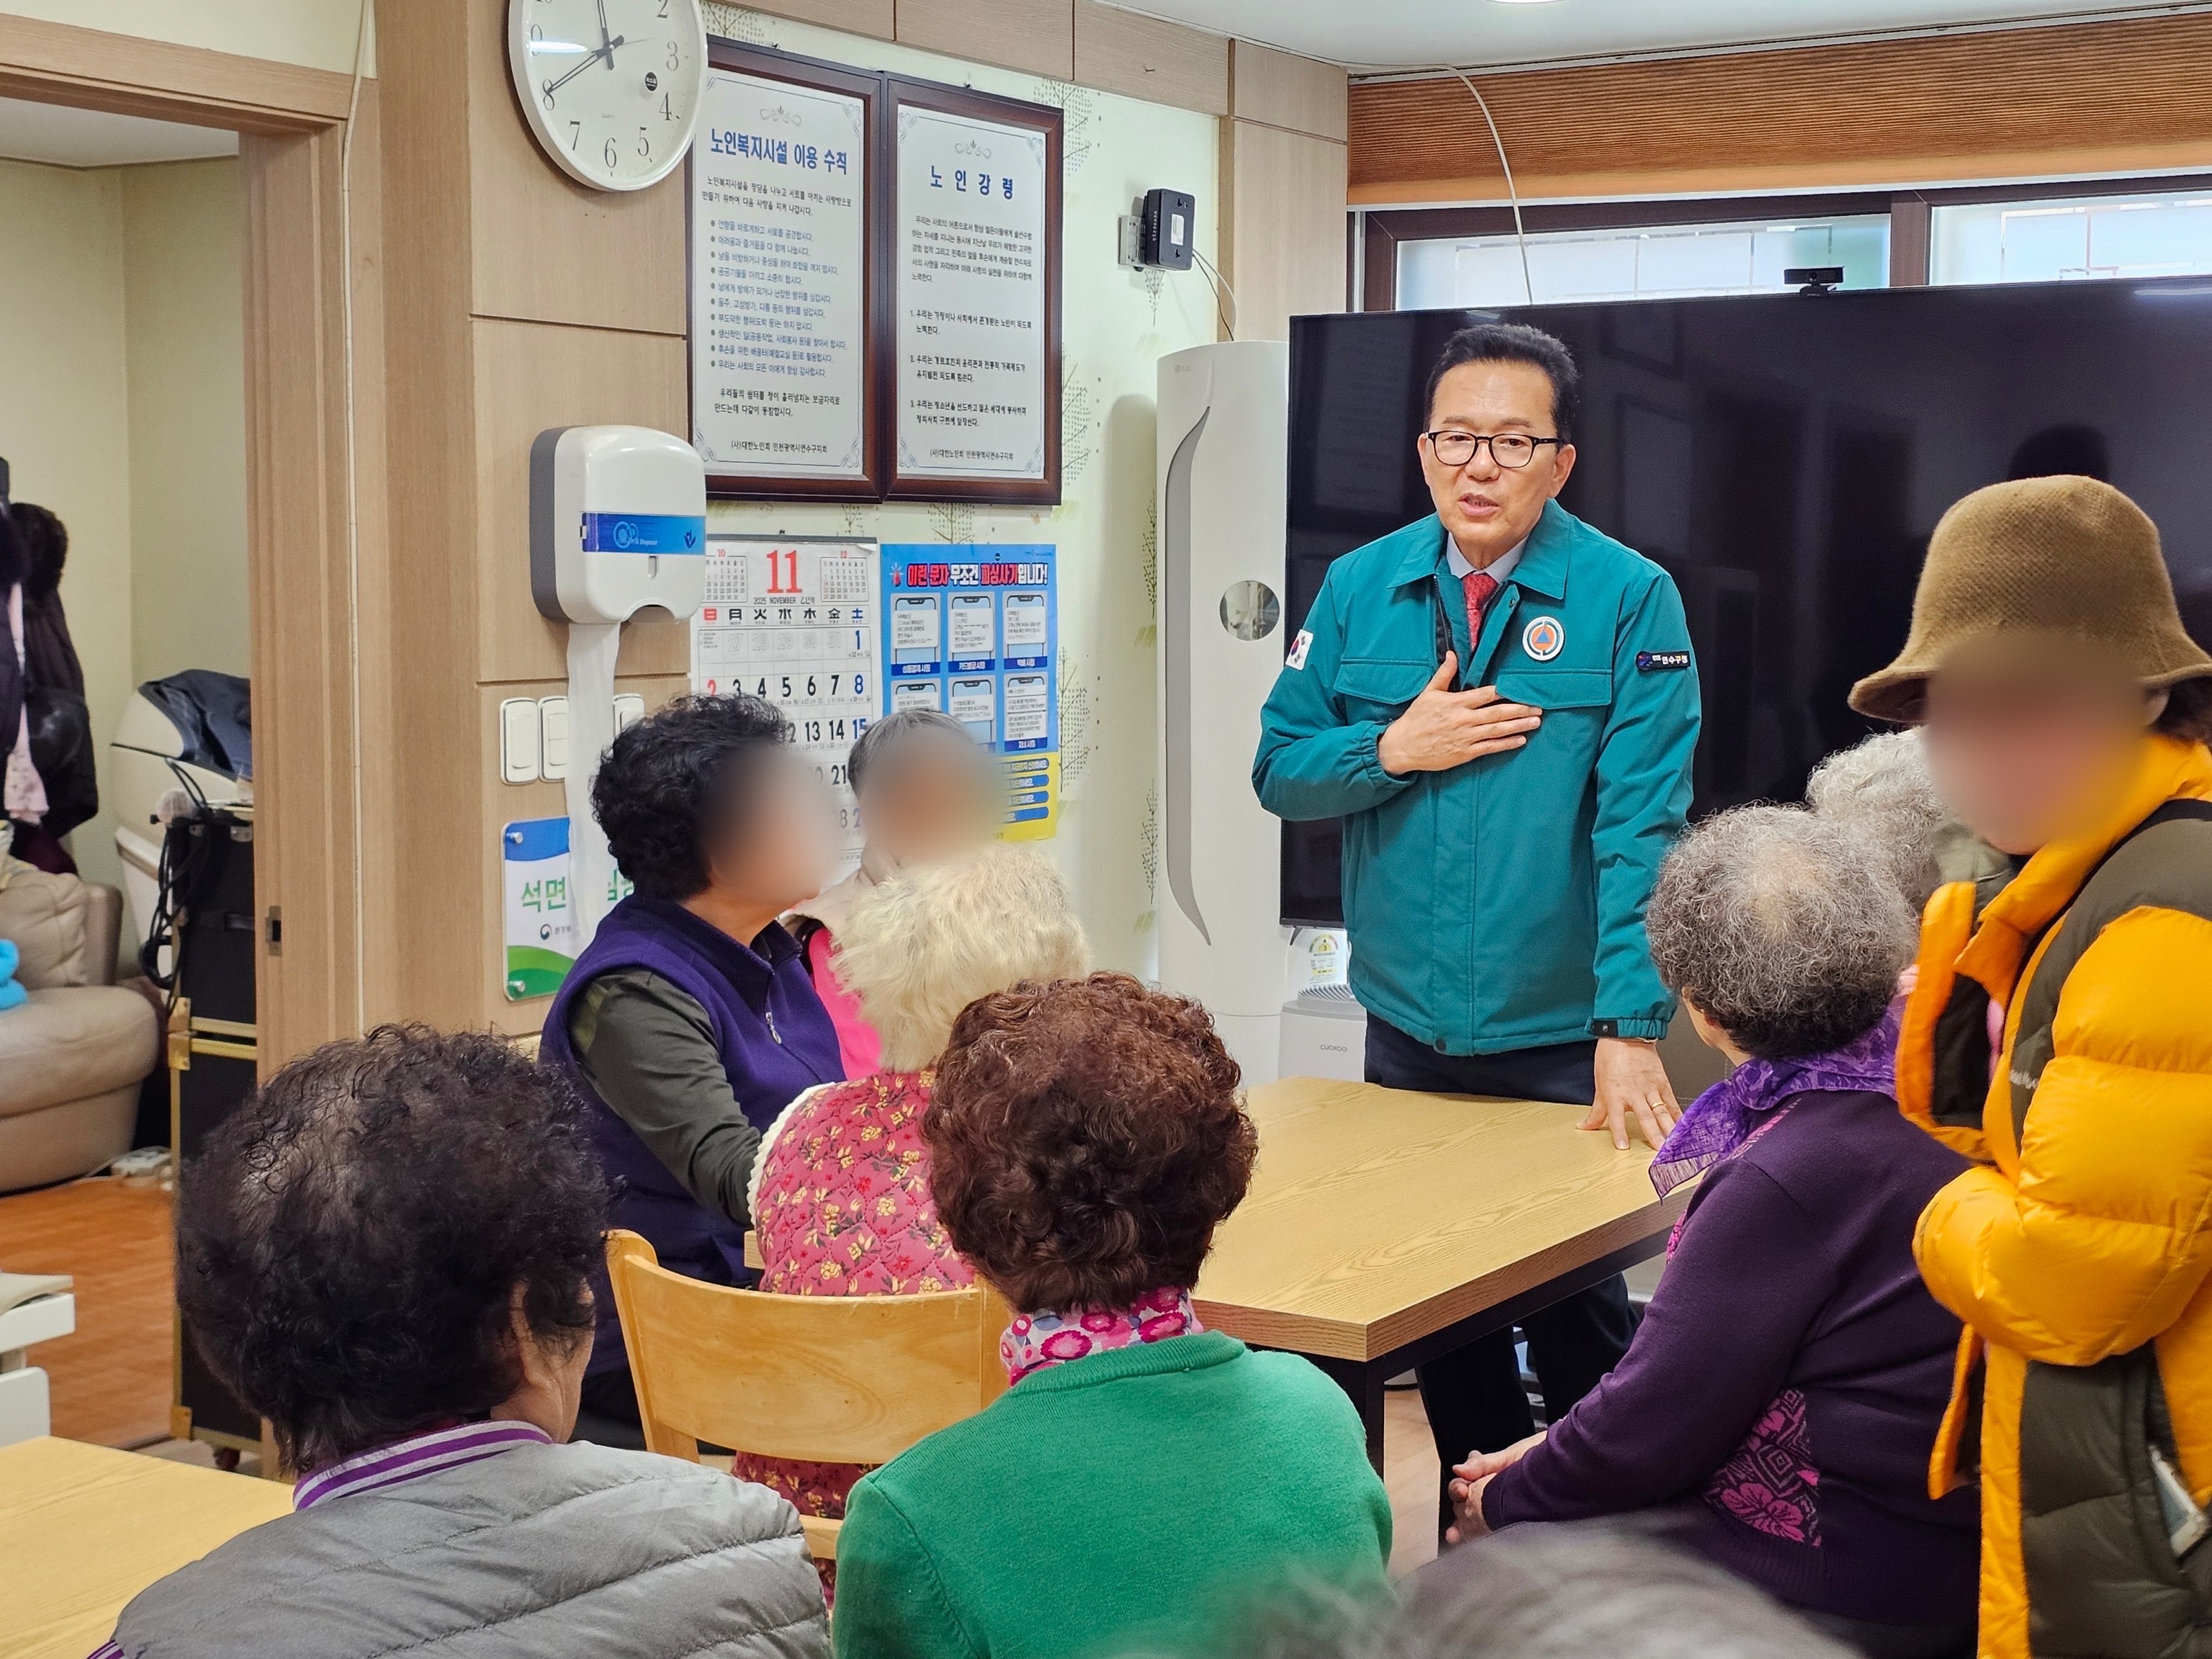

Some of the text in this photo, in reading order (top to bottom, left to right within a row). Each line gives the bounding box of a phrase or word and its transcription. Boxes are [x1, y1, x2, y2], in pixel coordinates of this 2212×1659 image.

[657, 0, 668, 19] 2
[667, 40, 678, 71] 3
[542, 79, 554, 111] 8
[659, 91, 672, 121] 4
[570, 120, 580, 151] 7
[637, 127, 649, 157] 5
[604, 137, 616, 168] 6
[711, 128, 847, 174] 노인복지시설 이용 수칙
[707, 176, 747, 191] 노인복지시설을
[770, 186, 786, 197] 나누고
[790, 189, 804, 200] 서로를
[826, 195, 851, 207] 사랑방으로
[930, 165, 1013, 199] 노 인 강 령
[702, 191, 812, 216] 만들기 위하여 다음 사항을 지켜 나갑시다.
[768, 227, 783, 237] 서로를
[718, 235, 741, 247] 어려움과
[775, 243, 785, 253] 함께
[718, 252, 729, 261] 남을
[749, 271, 765, 280] 아끼고
[786, 275, 803, 285] 합시다.
[783, 320, 794, 330] 하지
[917, 310, 932, 319] 우리는
[935, 311, 956, 322] 가정이나
[957, 313, 977, 324] 사회에서
[1001, 318, 1015, 328] 노인이
[718, 329, 741, 340] 생산적인
[831, 339, 847, 349] 합시다.
[917, 325, 940, 335] 노력한다.
[738, 346, 749, 356] 위한
[917, 355, 932, 364] 우리는
[718, 360, 827, 377] 우리는 사회의 모든 이에게 항상 감사합시다.
[940, 372, 956, 381] 되도록
[721, 388, 744, 399] 우리들의
[747, 390, 765, 400] 쉼터를
[768, 392, 779, 401] 정이
[813, 395, 840, 405] 보금자리로
[917, 400, 932, 409] 우리는
[714, 403, 793, 417] 만드는데 다같이 동참합시다.
[917, 415, 979, 427] 정의사회 구현에 앞장선다.
[732, 441, 827, 454] (사)대한노인회 인천광역시연수구지회
[717, 549, 725, 557] 10
[766, 549, 803, 593] 11
[907, 563, 927, 587] 이런
[929, 563, 950, 587] 문자
[950, 562, 980, 586] 무조건
[729, 609, 742, 620] 月
[754, 608, 767, 620] 火
[778, 608, 791, 620] 水
[804, 608, 817, 619] 木
[828, 608, 841, 619] 金
[852, 608, 863, 619] 土
[855, 630, 860, 650] 1
[757, 678, 767, 698] 4
[782, 677, 791, 697] 5
[807, 675, 817, 696] 6
[831, 675, 840, 696] 7
[854, 674, 864, 694] 8
[805, 721, 821, 742] 13
[829, 719, 845, 741] 14
[831, 764, 847, 785] 21
[520, 876, 567, 912] 석면
